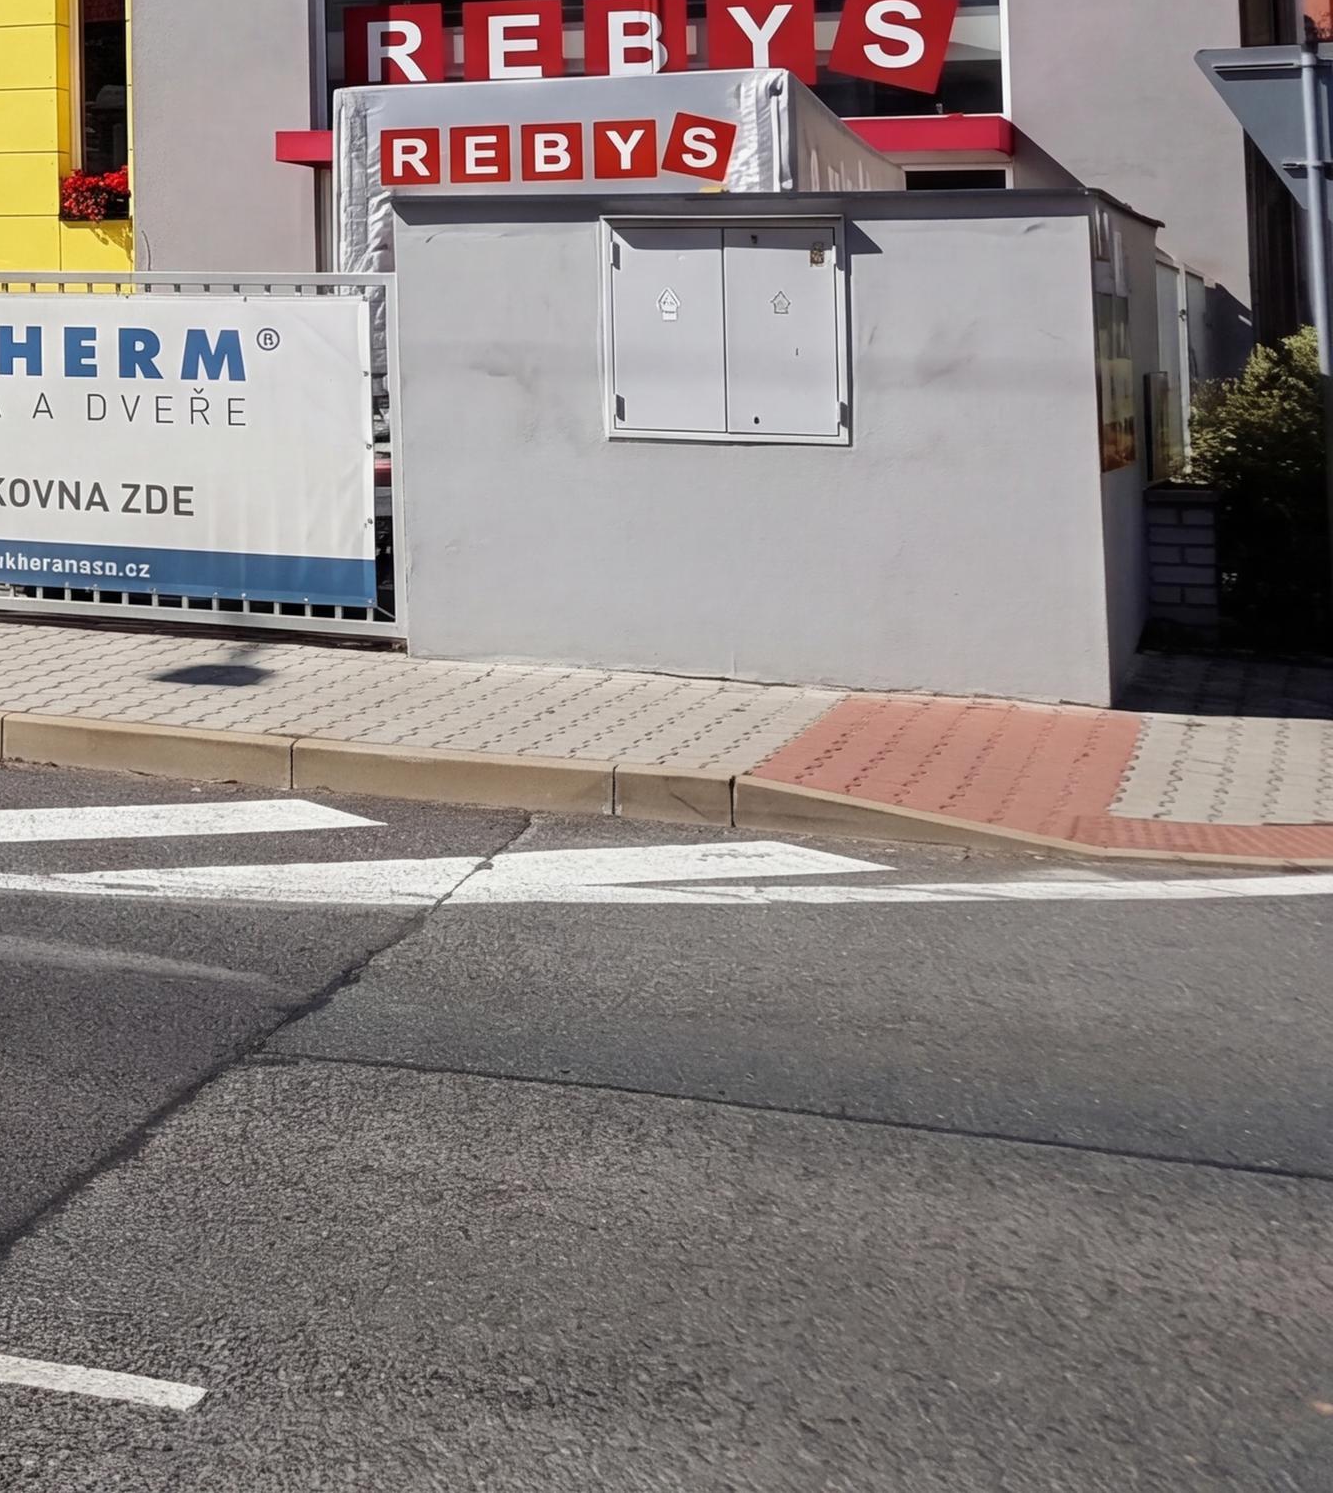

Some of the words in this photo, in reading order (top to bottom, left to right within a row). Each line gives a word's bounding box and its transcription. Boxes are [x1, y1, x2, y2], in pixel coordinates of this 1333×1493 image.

[391, 124, 720, 177] REBYS
[32, 392, 54, 419] A
[87, 388, 247, 426] DVEŘE
[121, 483, 194, 516] ZDE
